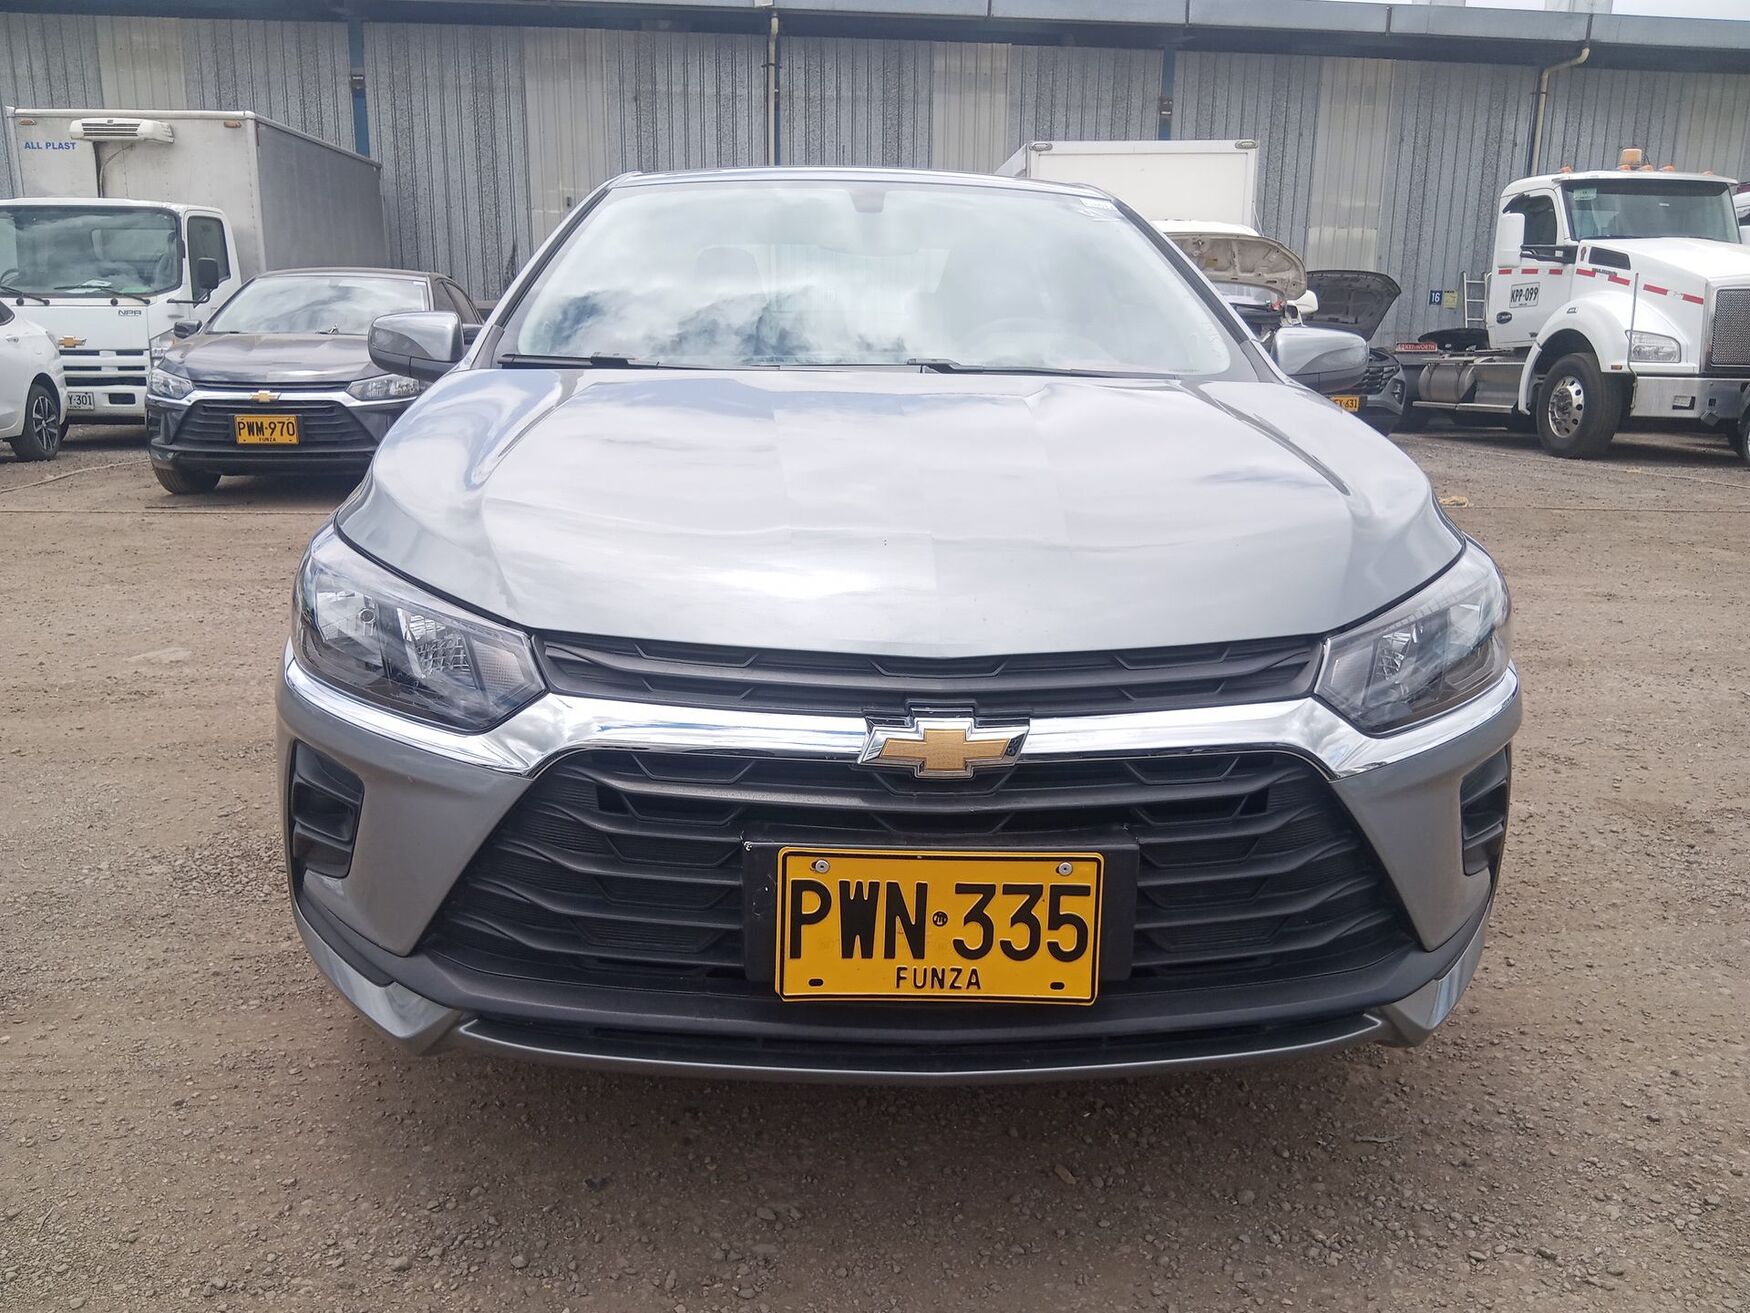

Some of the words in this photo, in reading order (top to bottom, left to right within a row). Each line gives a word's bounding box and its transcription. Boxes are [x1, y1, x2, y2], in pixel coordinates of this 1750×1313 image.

[24, 141, 43, 150] ALL
[45, 141, 76, 150] PLAST
[1431, 292, 1441, 303] 16
[895, 966, 981, 990] FUNZA
